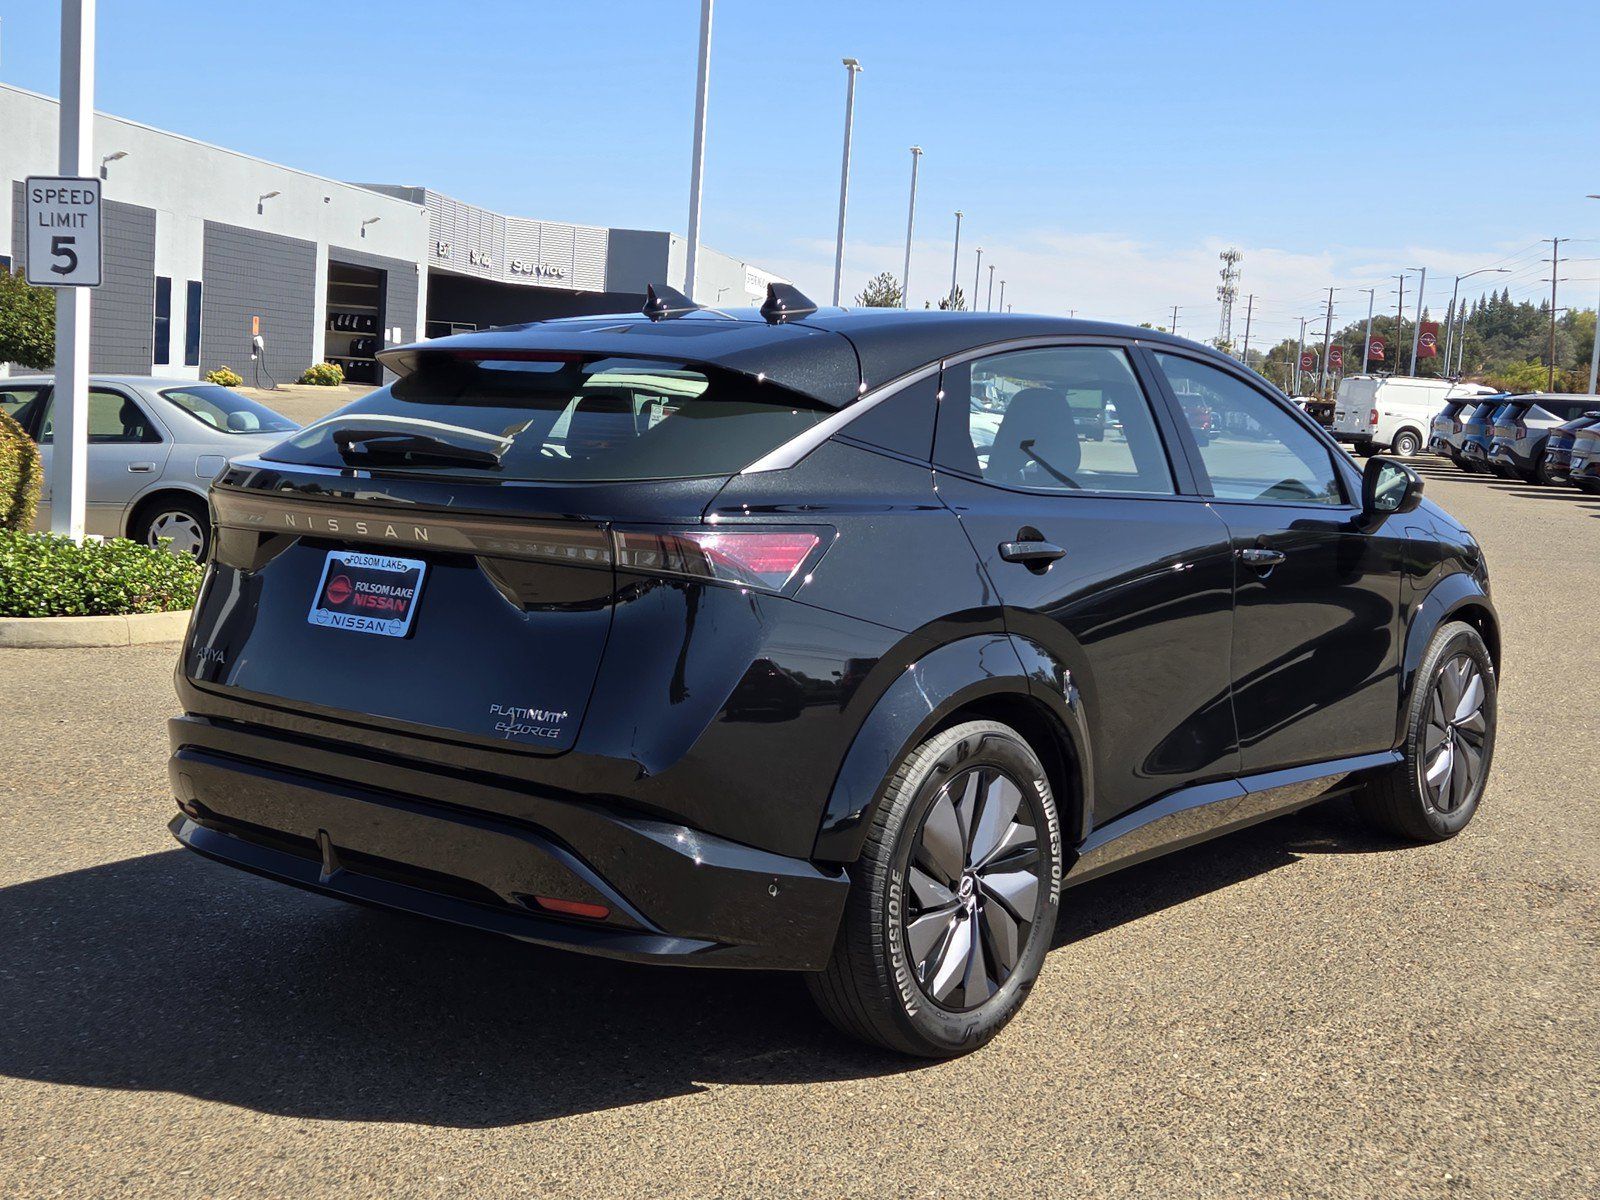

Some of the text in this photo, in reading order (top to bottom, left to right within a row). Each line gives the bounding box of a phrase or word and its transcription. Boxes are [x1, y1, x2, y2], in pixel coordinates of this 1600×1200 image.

[32, 188, 95, 205] SPEED
[39, 212, 88, 228] LIMIT
[50, 235, 78, 275] 5
[511, 259, 566, 278] Service
[285, 514, 429, 541] NISSAN
[350, 555, 402, 570] FOLSOM LAKE
[355, 581, 414, 598] FOLSOM LAKE
[352, 593, 407, 611] NISSAN
[330, 614, 386, 632] NISSAN
